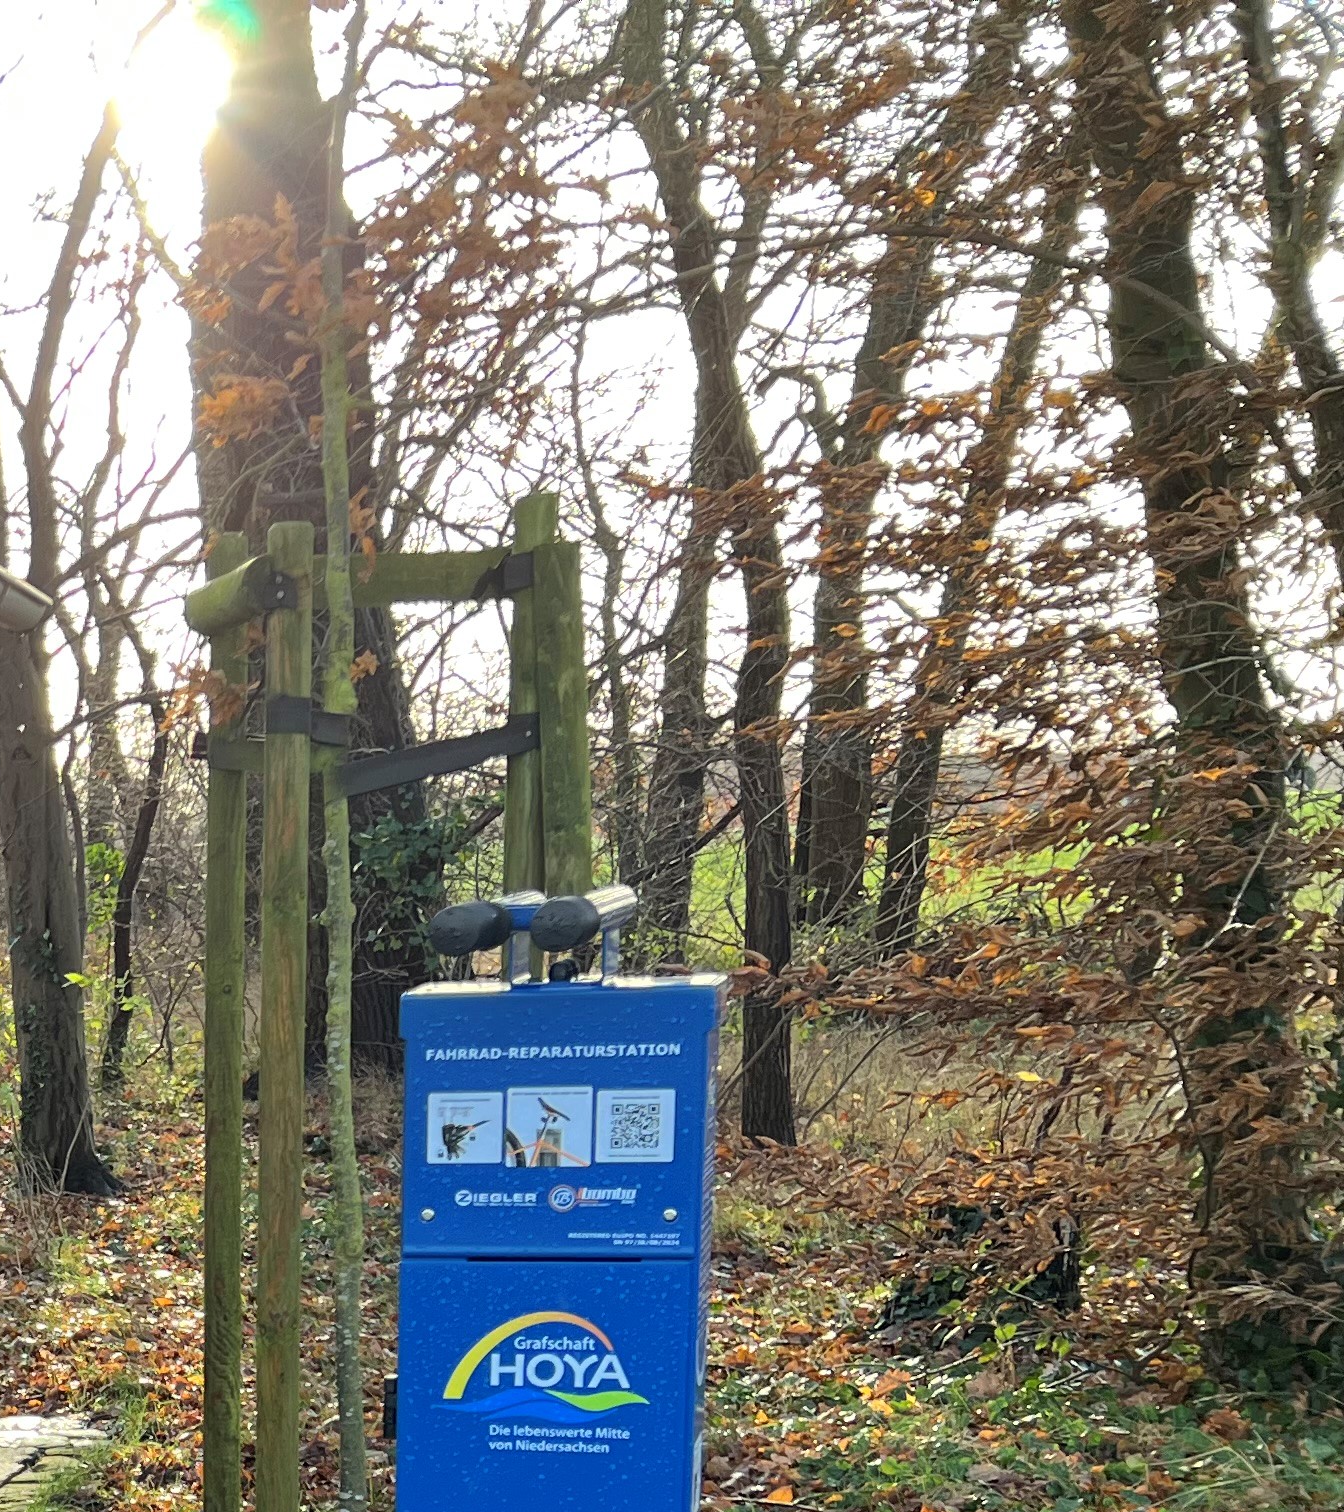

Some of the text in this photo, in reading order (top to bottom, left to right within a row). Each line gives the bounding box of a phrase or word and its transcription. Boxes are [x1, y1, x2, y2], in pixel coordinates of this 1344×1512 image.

[425, 1043, 681, 1061] FAHRRAD-REPARATURSTATION
[455, 1189, 537, 1206] ZIEGLER
[514, 1336, 595, 1351] Grafschaft
[489, 1353, 631, 1388] HOYA
[489, 1424, 631, 1440] Die lebenswerte Mitte
[489, 1440, 610, 1454] von Niedersachsen
